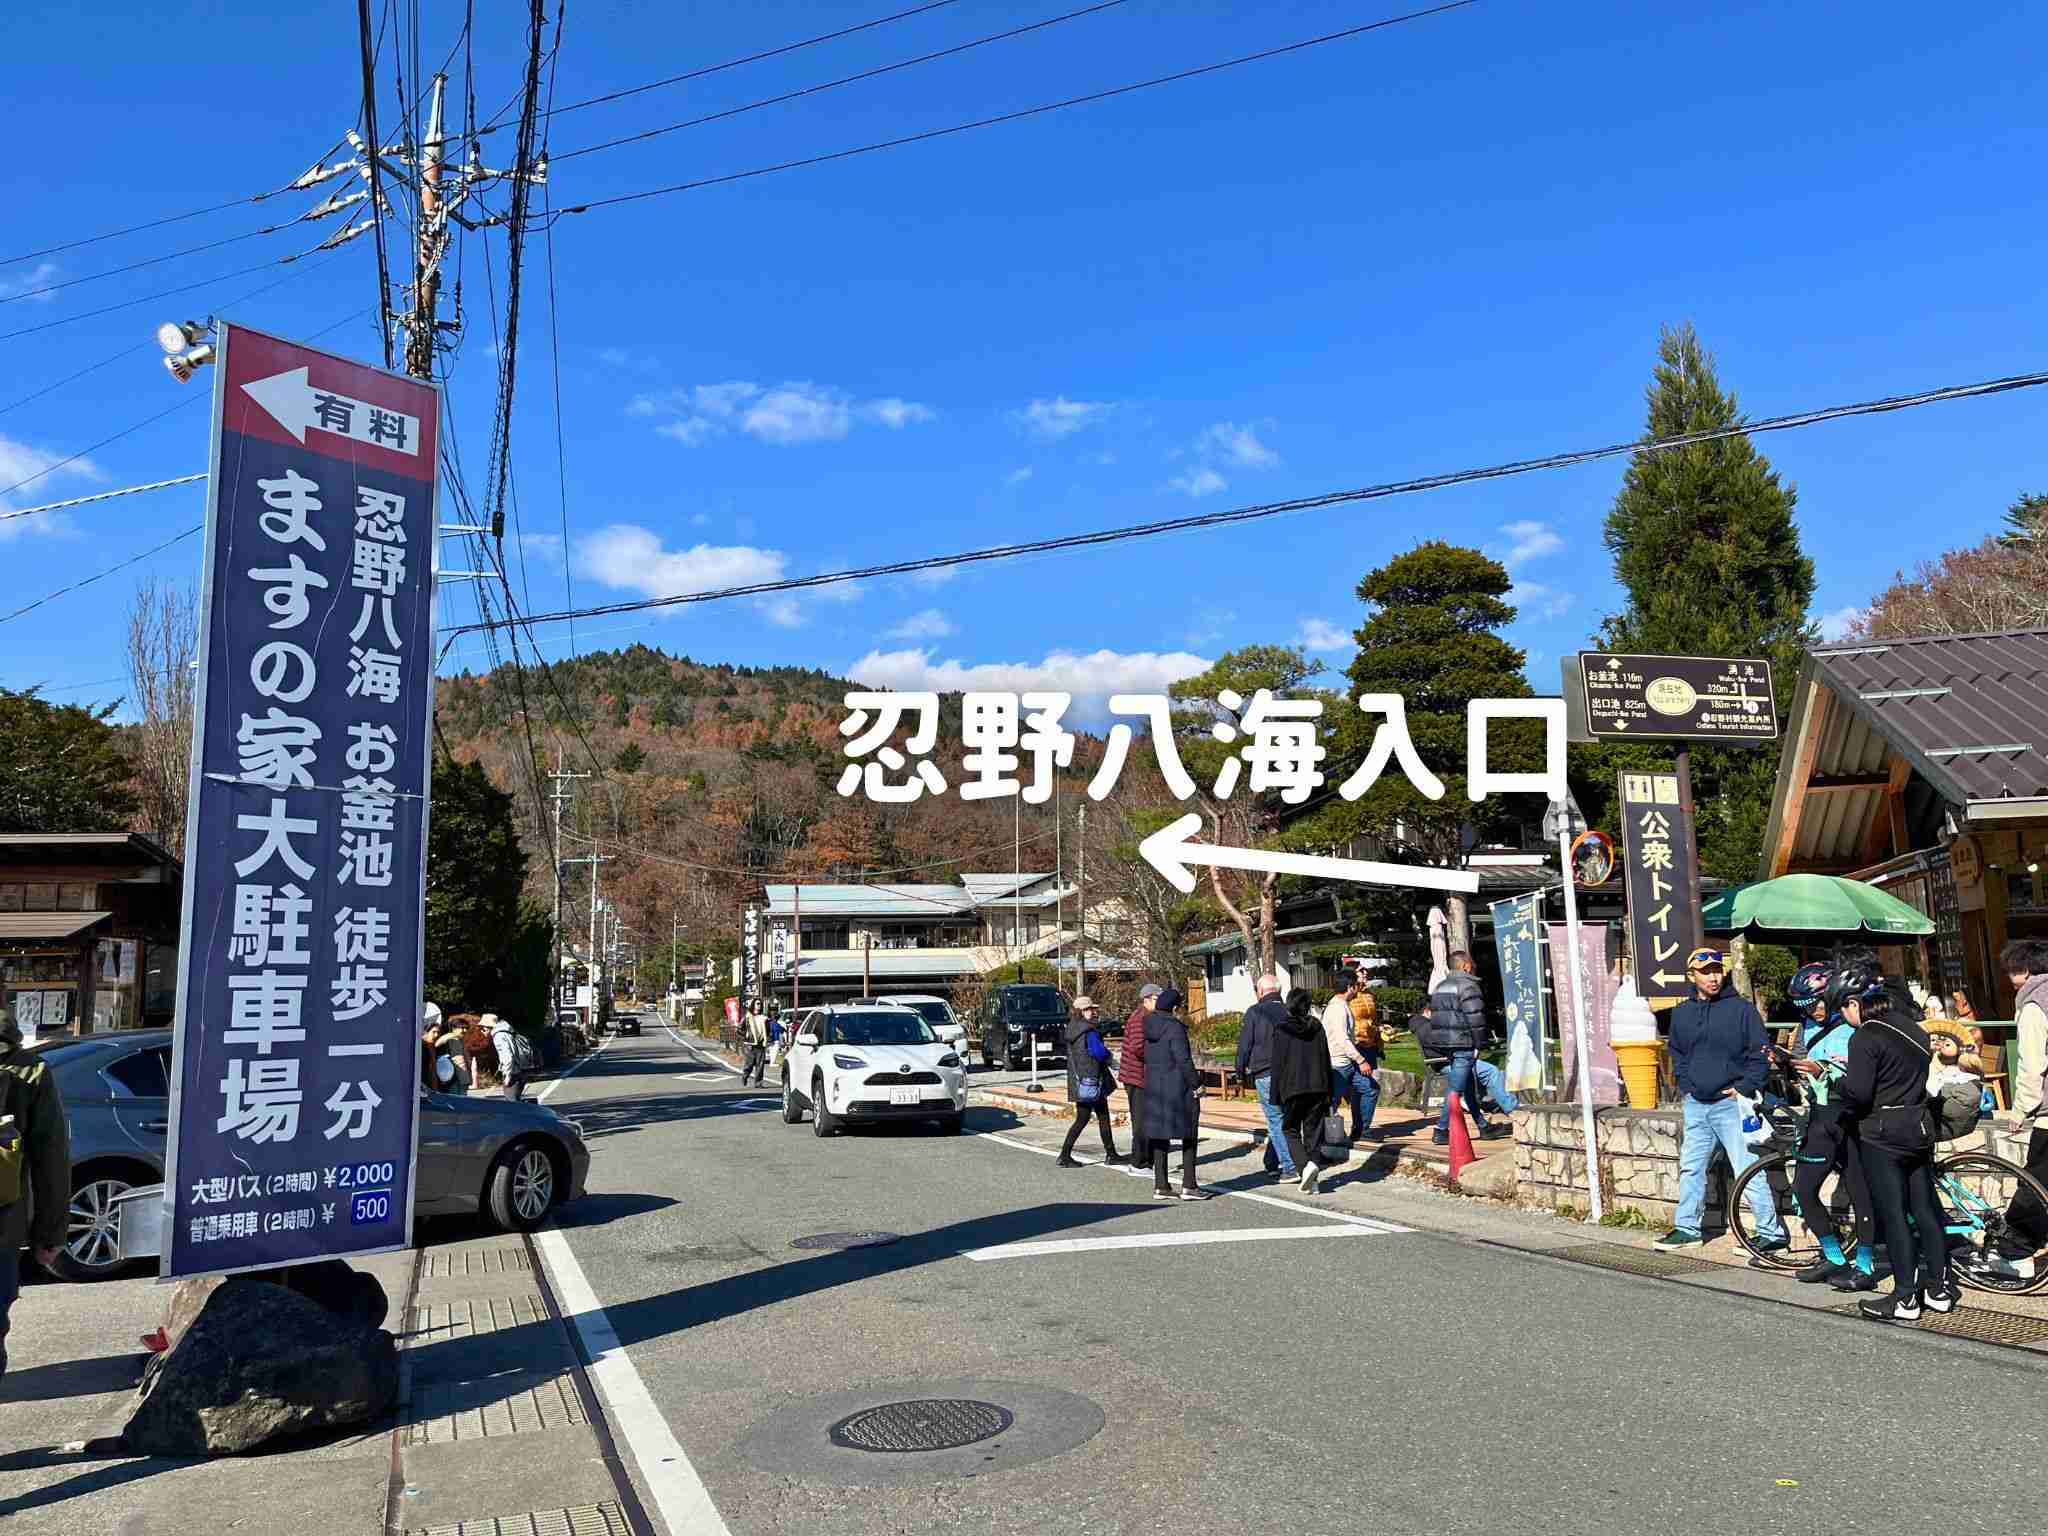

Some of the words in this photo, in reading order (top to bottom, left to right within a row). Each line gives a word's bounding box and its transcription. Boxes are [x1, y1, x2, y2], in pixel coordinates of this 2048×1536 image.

[314, 393, 408, 449] 有料
[346, 486, 406, 704] 忍野八海
[1588, 670, 1618, 682] お釜池
[1592, 697, 1621, 710] 出口池
[217, 469, 329, 1145] ますの家大駐車場
[337, 721, 400, 888] お釜池
[1639, 809, 1680, 962] 公衆トイレ
[323, 905, 392, 1142] 徒歩一分
[356, 1195, 389, 1221] 500
